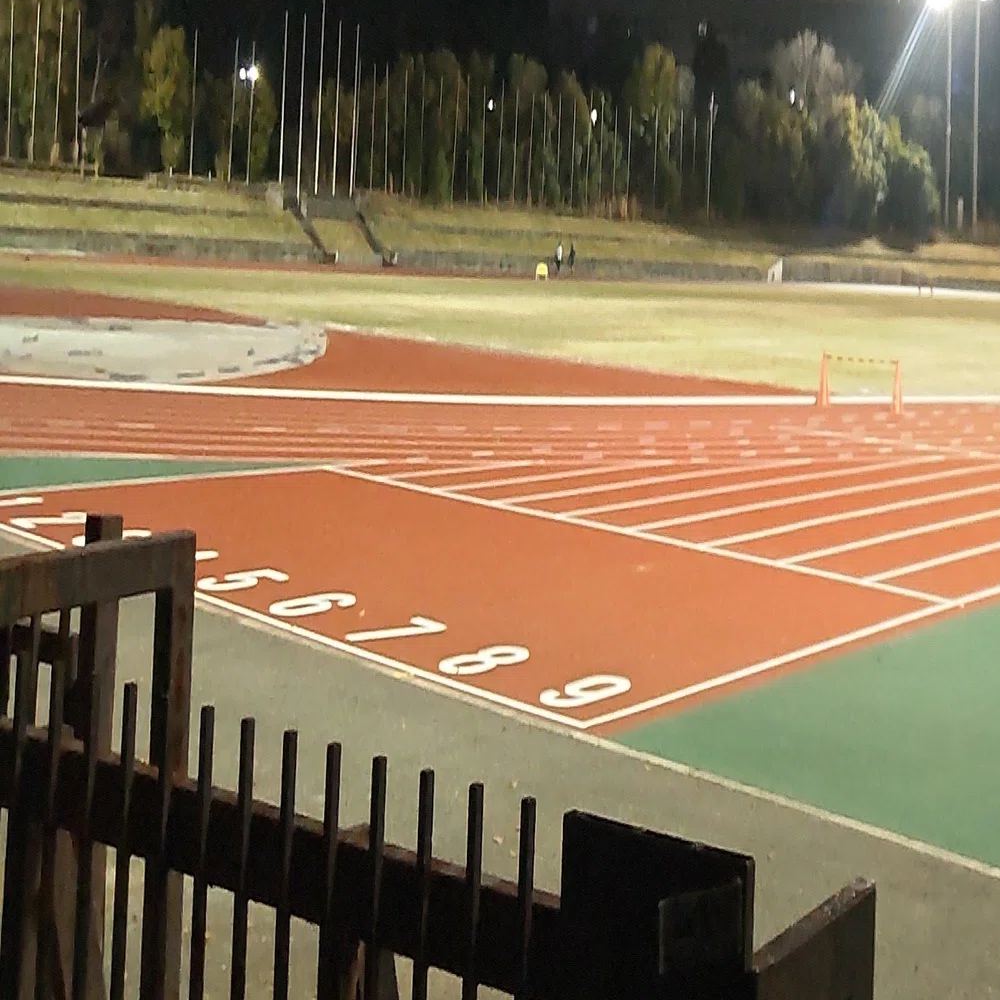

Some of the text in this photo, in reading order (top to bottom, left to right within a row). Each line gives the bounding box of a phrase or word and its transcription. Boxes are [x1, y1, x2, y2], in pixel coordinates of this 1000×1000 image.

[196, 567, 289, 591] 5
[268, 592, 357, 617] 6
[345, 616, 447, 642] 7
[438, 645, 530, 675] 8
[539, 674, 632, 708] 9
